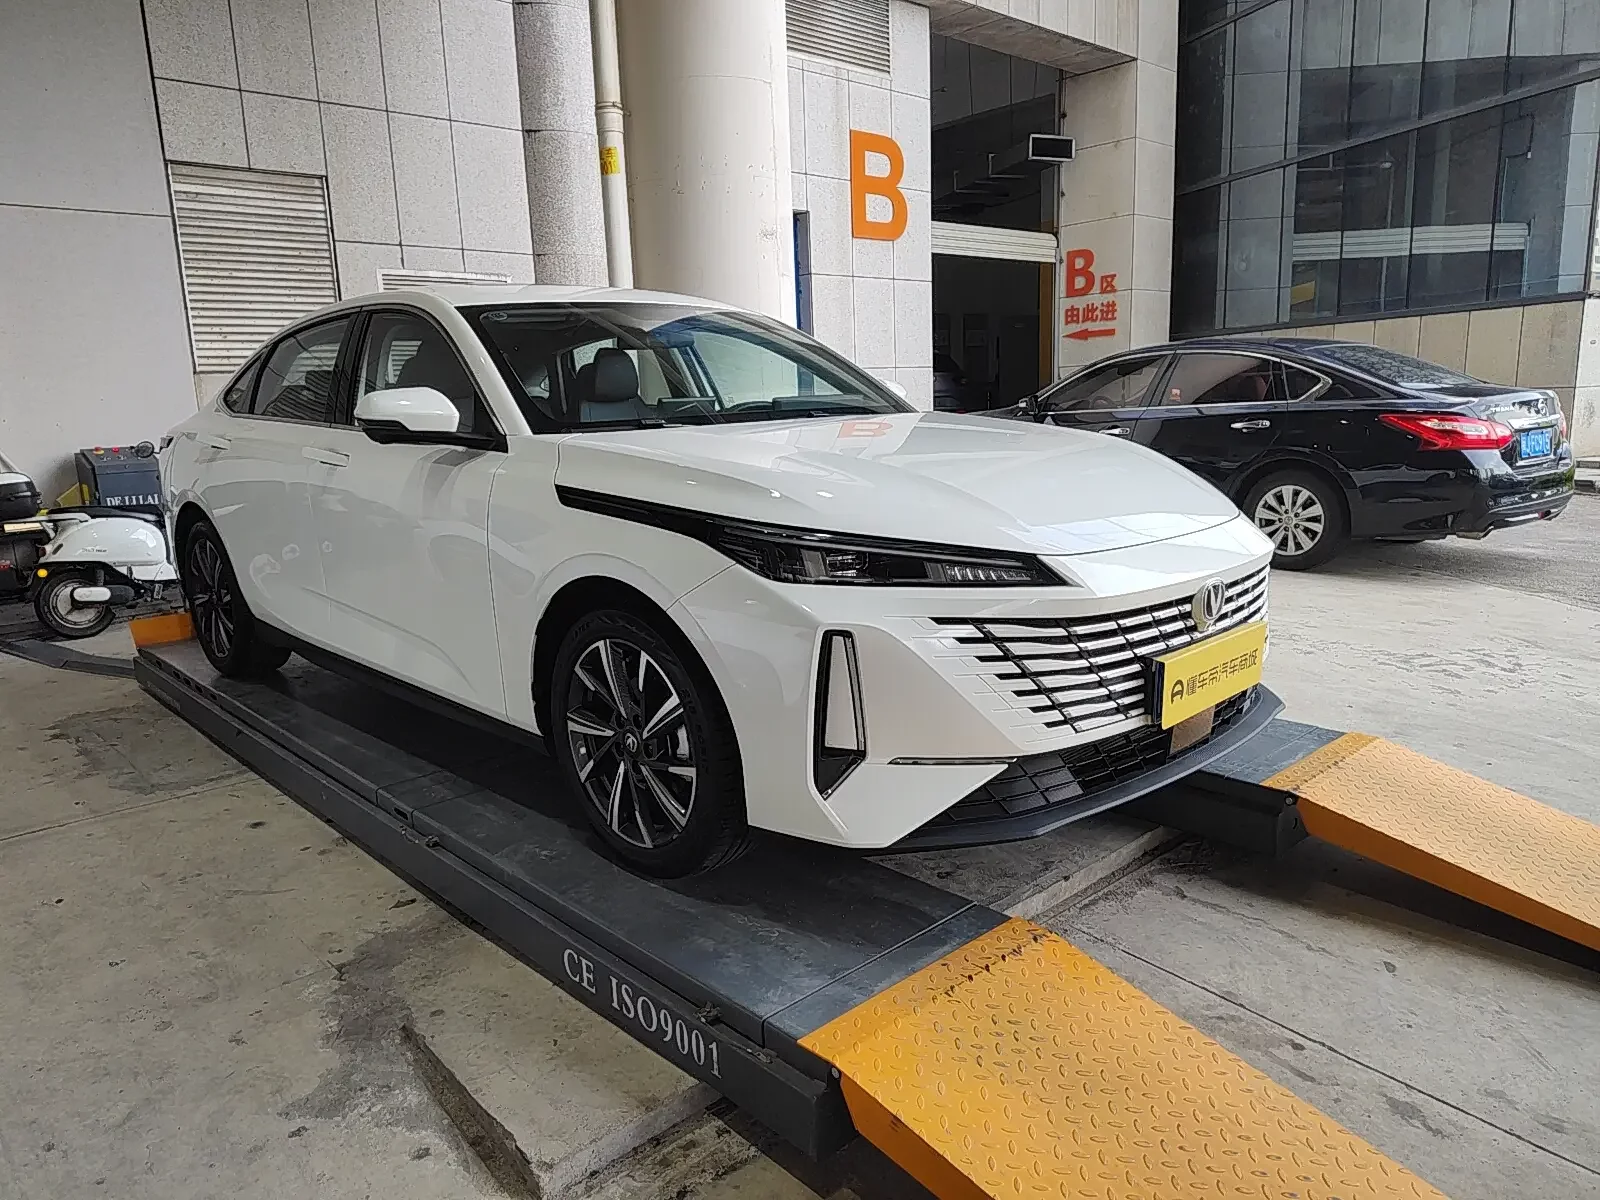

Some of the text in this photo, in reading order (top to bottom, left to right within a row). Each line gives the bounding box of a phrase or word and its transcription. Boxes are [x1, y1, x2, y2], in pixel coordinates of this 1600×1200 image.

[850, 128, 908, 241] B
[1065, 300, 1117, 325] 由此进
[564, 949, 722, 1079] CE ISO9001
